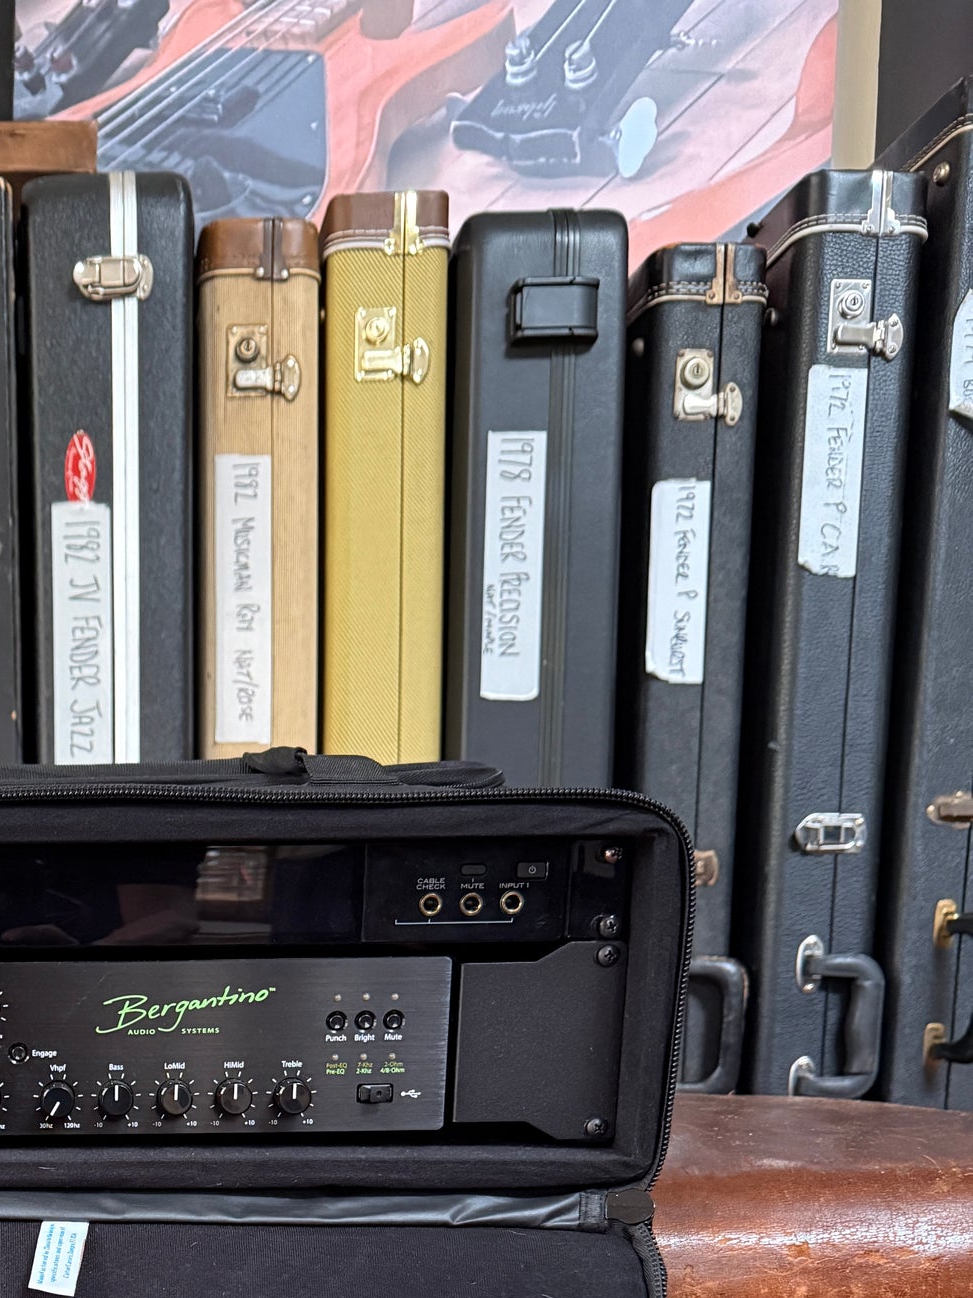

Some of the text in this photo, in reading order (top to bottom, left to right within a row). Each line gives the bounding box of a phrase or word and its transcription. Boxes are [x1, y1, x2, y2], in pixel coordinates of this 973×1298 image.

[828, 373, 852, 417] 1972
[825, 427, 849, 490] FENDER
[232, 462, 260, 506] 1982
[824, 501, 848, 514] P
[497, 438, 534, 658] 1978 FENDER PRECISION
[232, 517, 258, 593] MUSICMAN
[674, 528, 698, 587] FENDER
[677, 590, 699, 599] P
[63, 520, 105, 759] 1982 JV FENDER JAZZ
[354, 1034, 375, 1042] Bright
[384, 1033, 403, 1041] Mute
[31, 1049, 57, 1058] Engage
[109, 1063, 124, 1071] Bass
[164, 1062, 185, 1070] LoMid
[224, 1061, 244, 1069] HiMid
[281, 1060, 303, 1068] Treble
